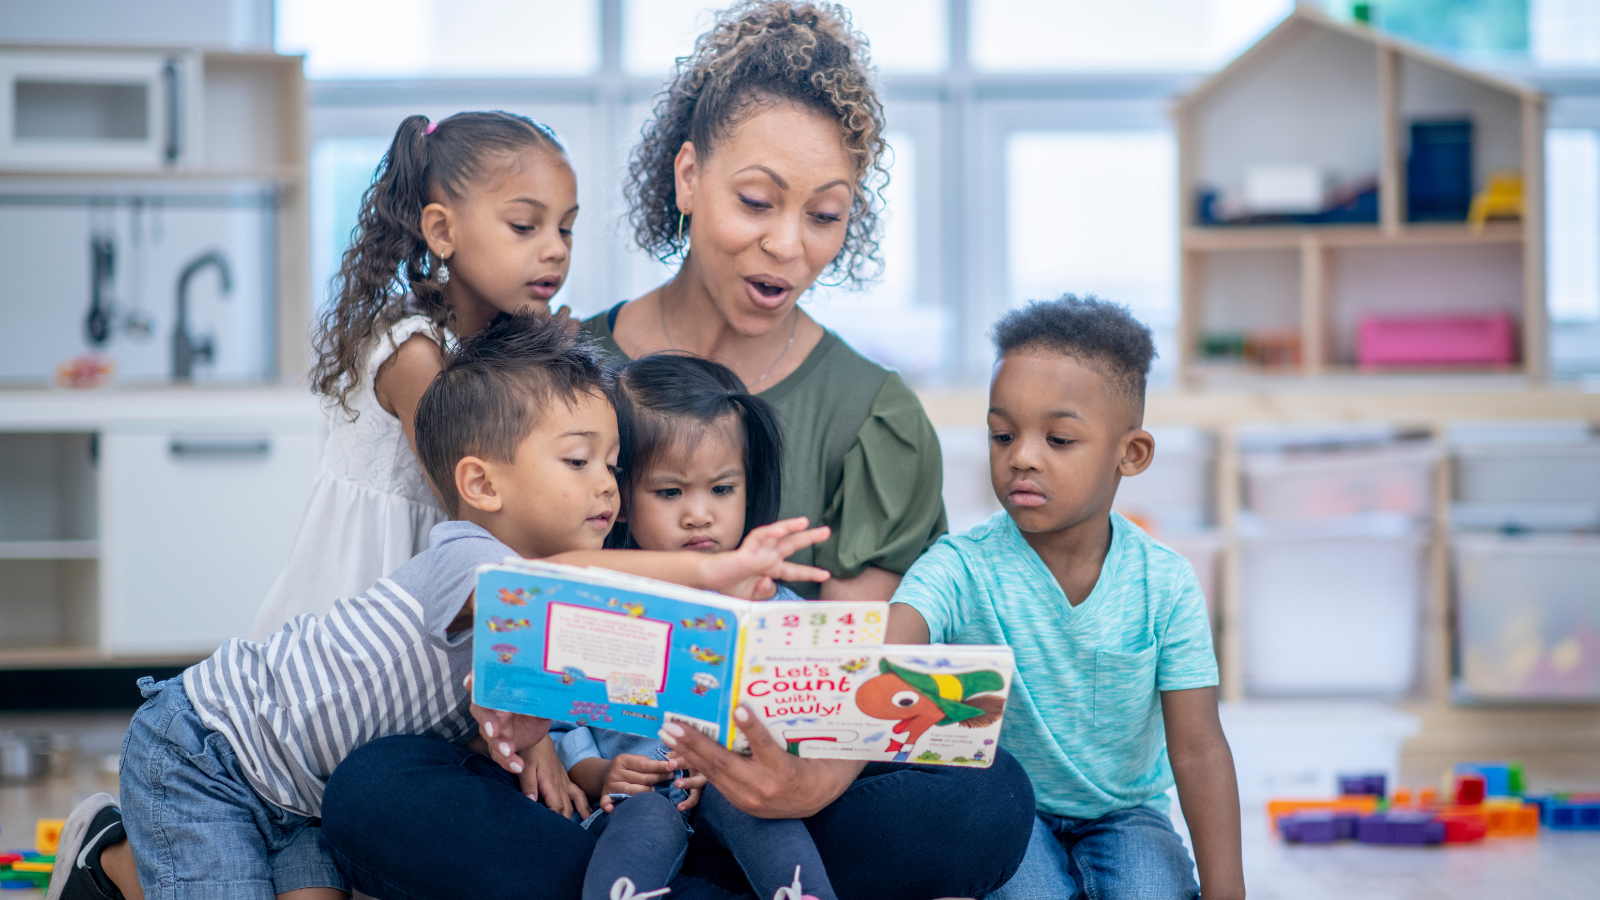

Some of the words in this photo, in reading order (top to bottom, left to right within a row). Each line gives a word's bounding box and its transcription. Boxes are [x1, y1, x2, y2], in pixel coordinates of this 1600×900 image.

[756, 617, 768, 630] 1
[782, 614, 800, 628] 2
[809, 612, 827, 626] 3
[837, 612, 856, 626] 4
[865, 611, 881, 624] 5
[774, 663, 830, 678] Let's
[747, 676, 851, 697] Count
[775, 693, 816, 704] with
[763, 702, 842, 718] Lowly!
